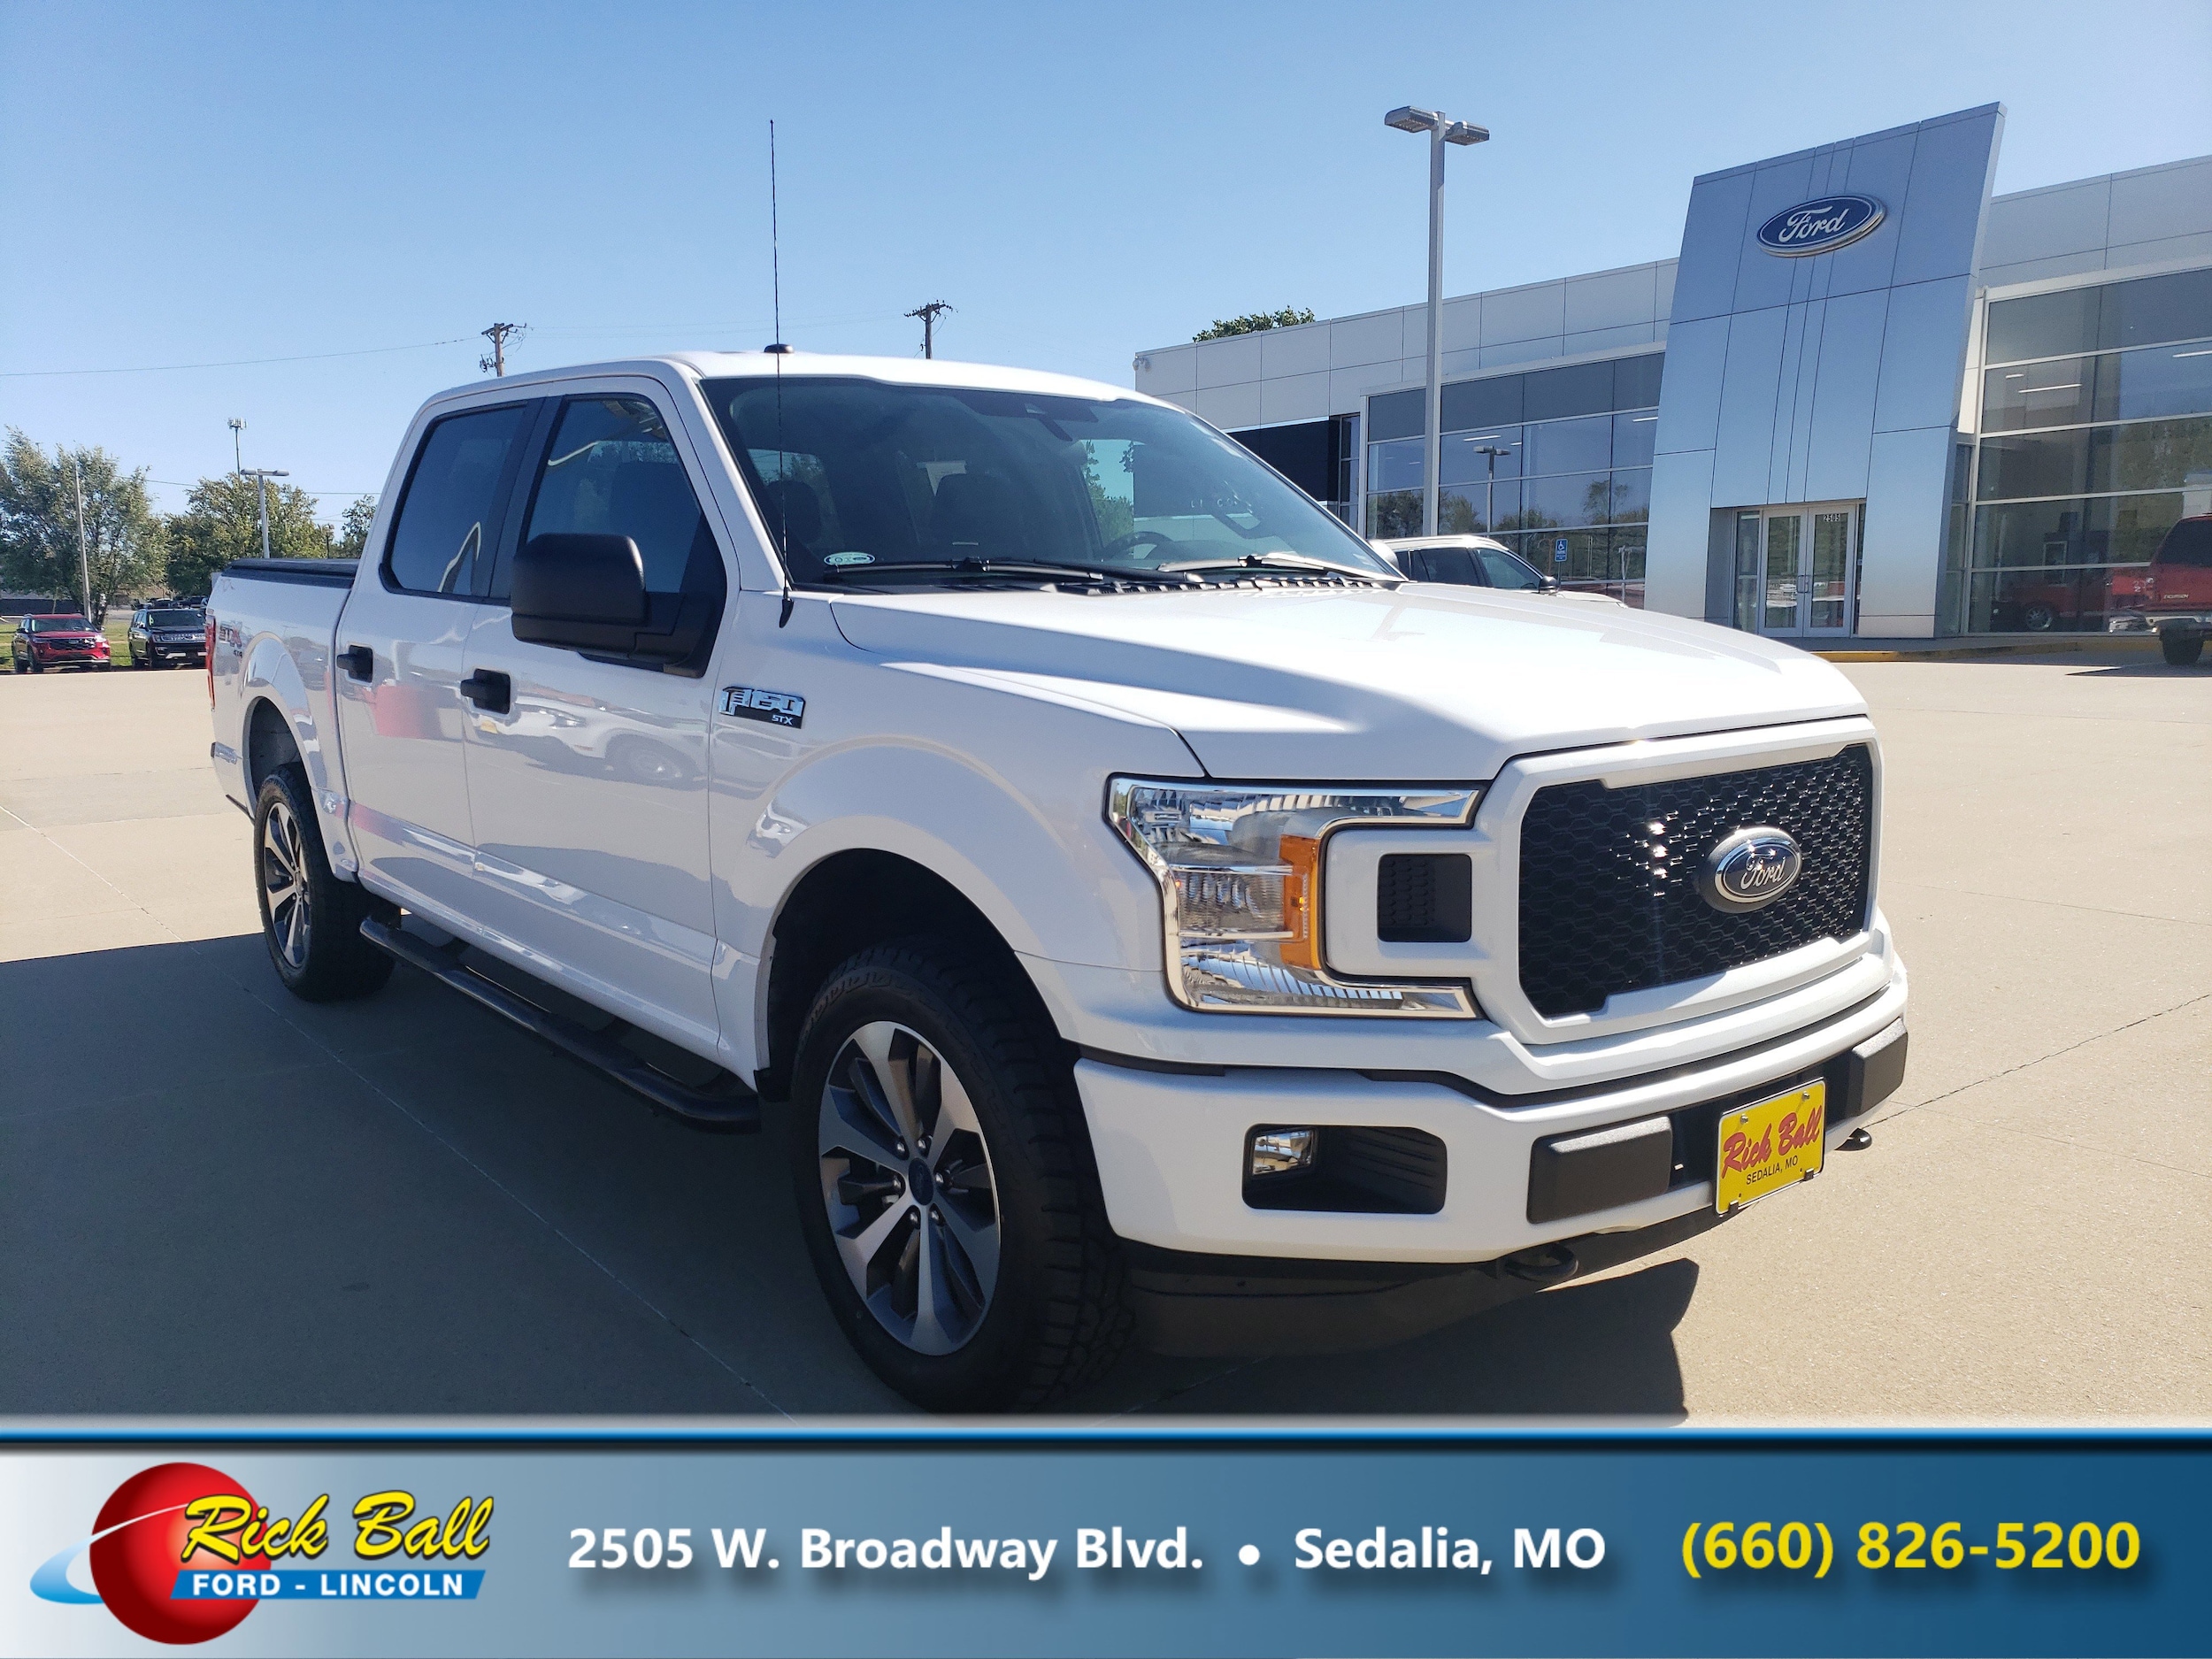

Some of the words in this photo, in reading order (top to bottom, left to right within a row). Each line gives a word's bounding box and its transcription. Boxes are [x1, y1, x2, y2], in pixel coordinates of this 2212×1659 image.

[1778, 204, 1850, 243] Ford
[1824, 513, 1840, 522] 2505
[771, 714, 795, 726] STX
[1740, 852, 1786, 890] Ford
[1721, 1123, 1772, 1179] Rick
[1778, 1105, 1823, 1156] Ball
[1746, 1163, 1784, 1186] SEDALIA,
[1785, 1155, 1799, 1171] MO
